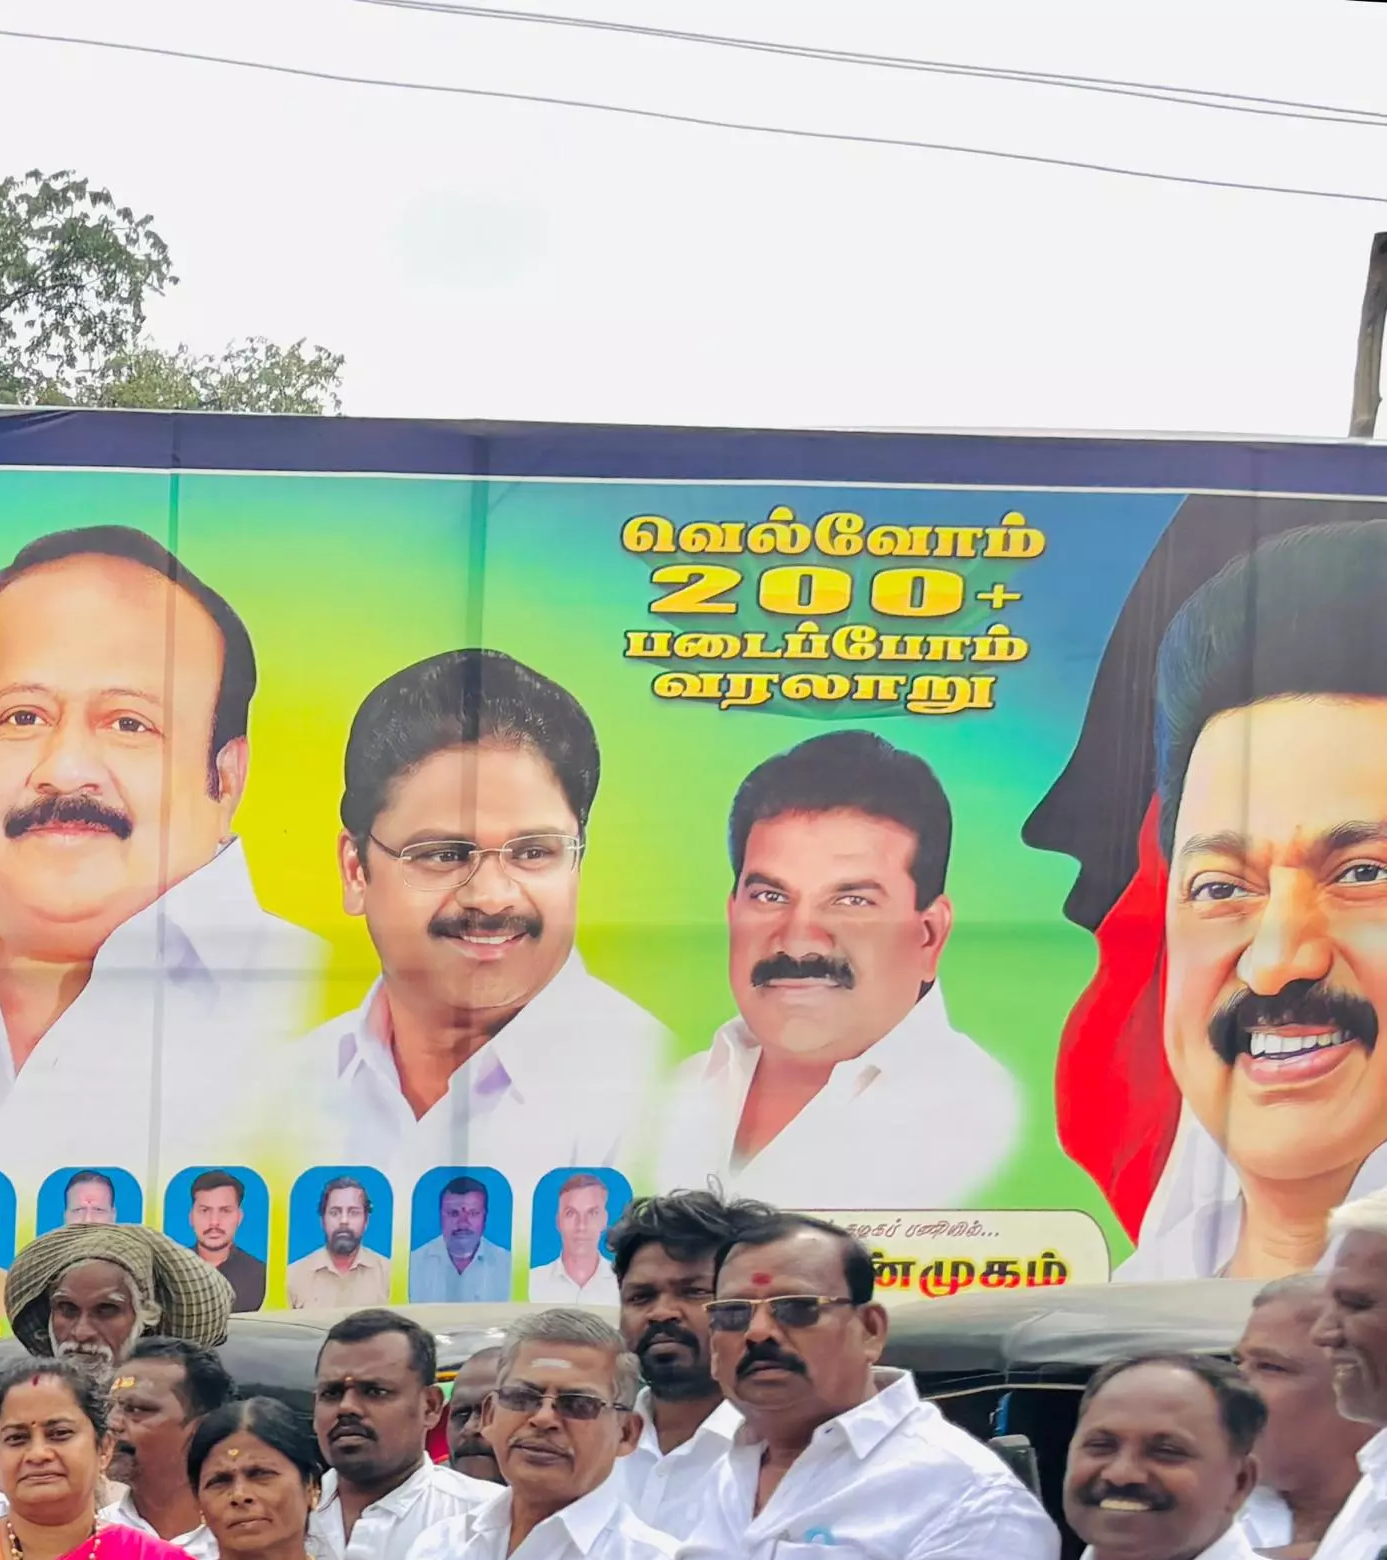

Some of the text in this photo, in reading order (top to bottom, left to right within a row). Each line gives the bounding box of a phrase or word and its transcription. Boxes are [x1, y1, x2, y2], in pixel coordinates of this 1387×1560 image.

[621, 506, 1046, 558] வெல்வோம்
[649, 563, 1023, 617] 200+
[624, 621, 1029, 662] படைப்போம்
[652, 671, 997, 714] வரலாறு
